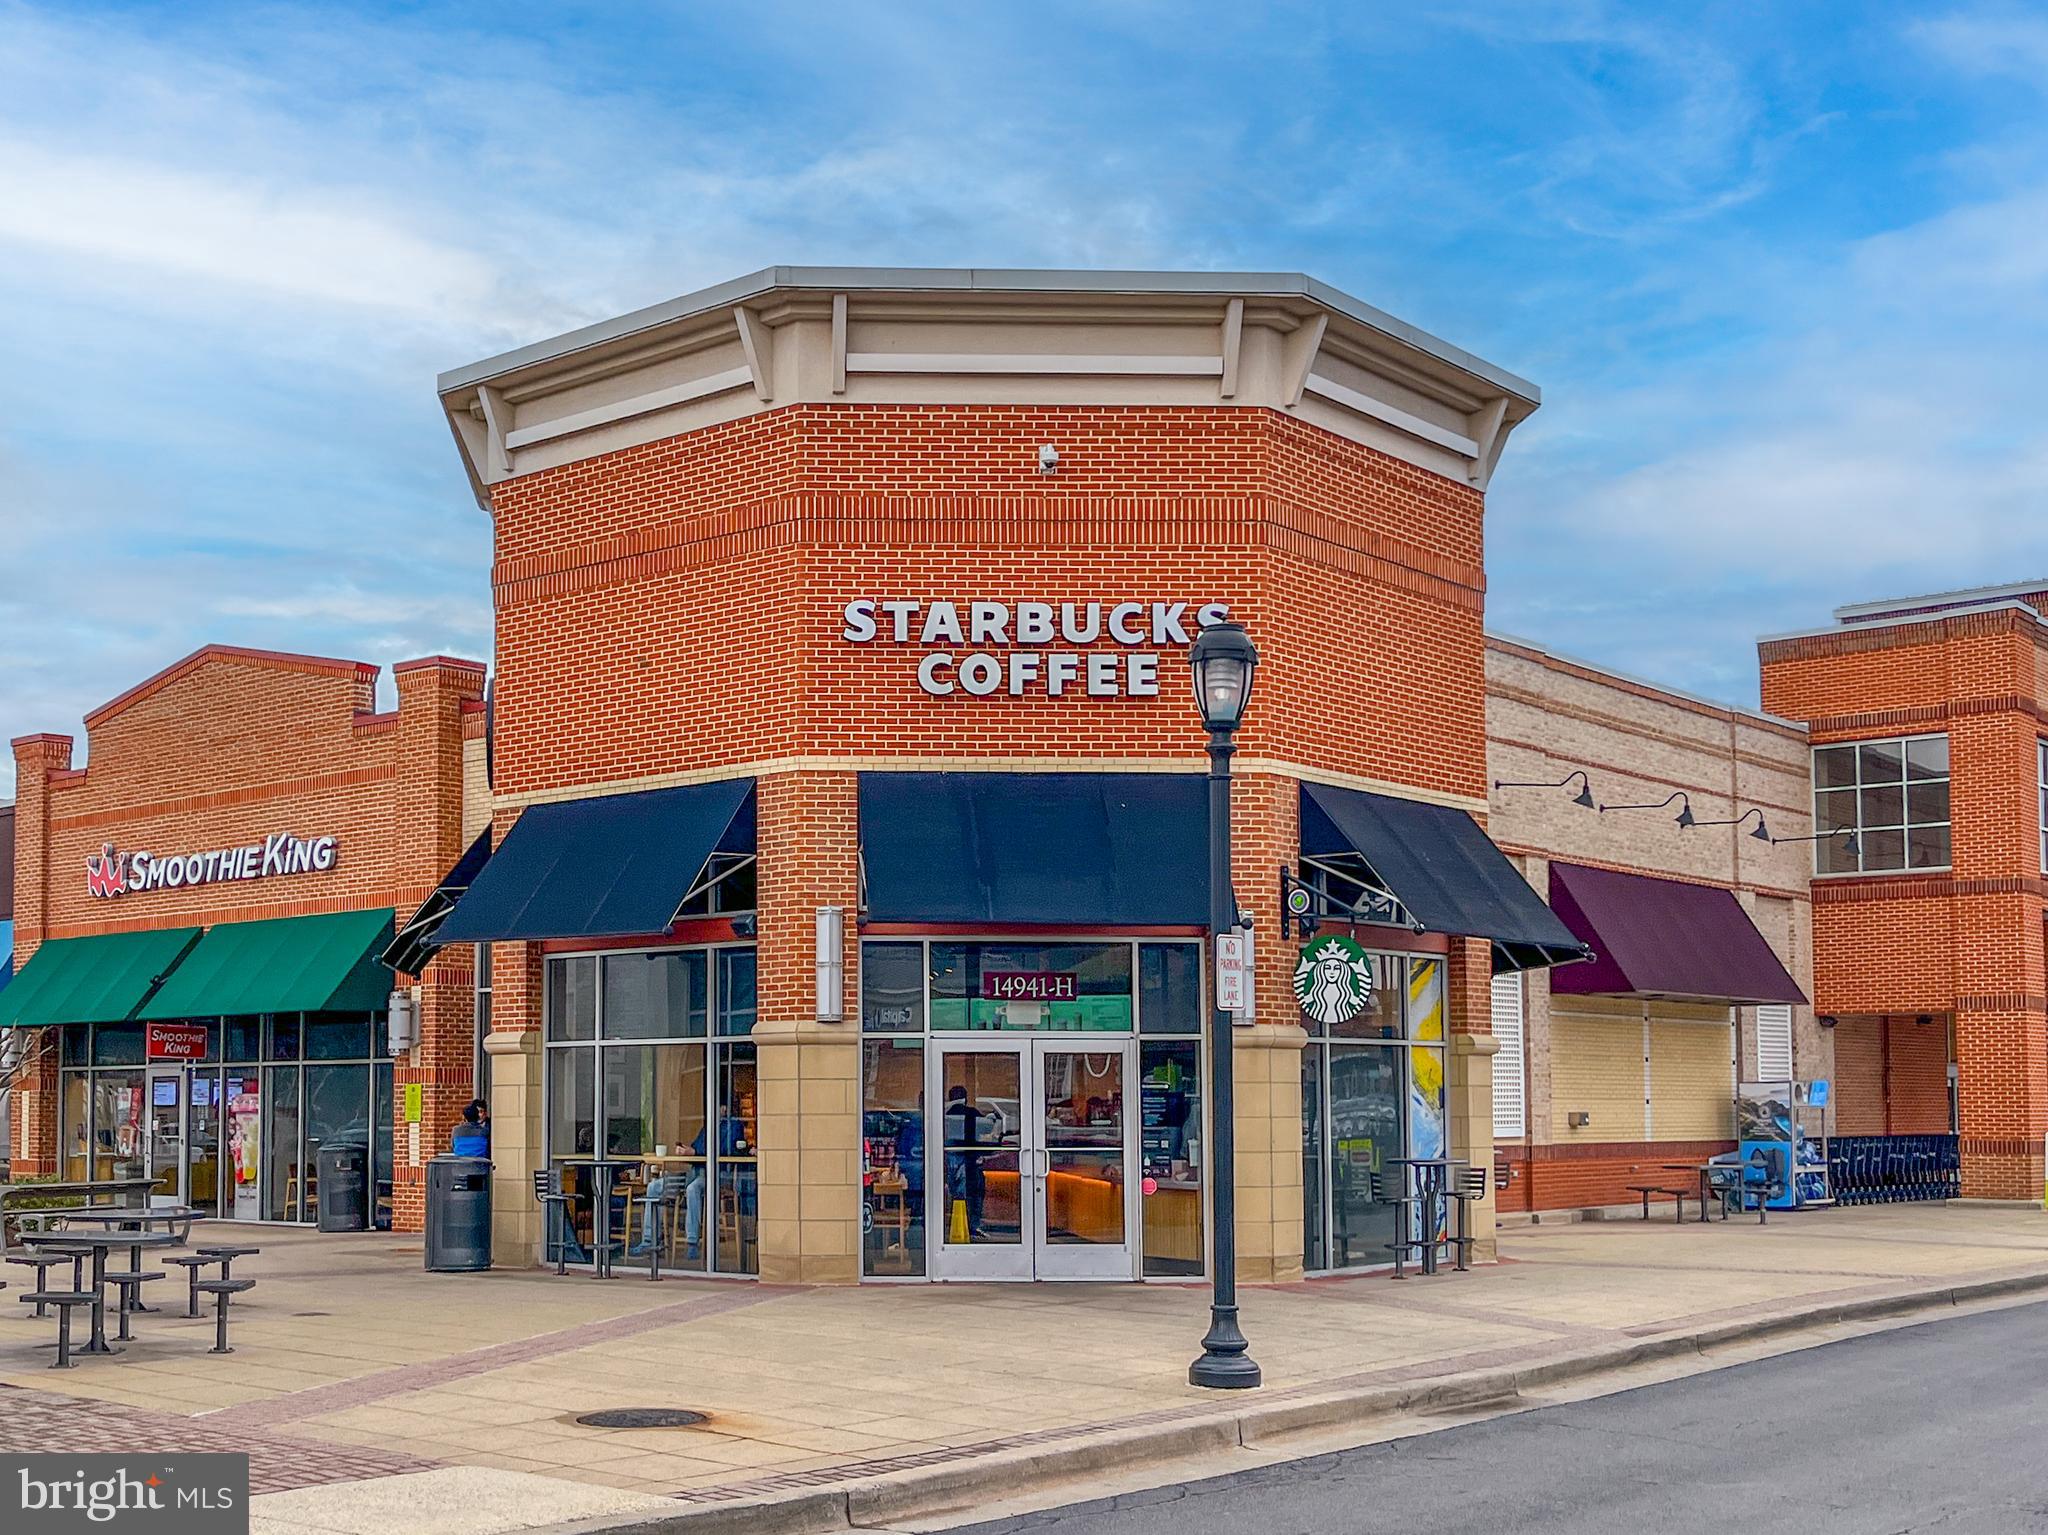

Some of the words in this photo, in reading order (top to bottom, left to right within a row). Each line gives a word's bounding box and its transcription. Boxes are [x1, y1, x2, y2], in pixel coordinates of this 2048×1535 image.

[843, 600, 1230, 645] STARBUCKS
[917, 653, 1159, 695] COFFEE
[129, 847, 260, 891] SMOOTHIE
[1225, 942, 1236, 955] NO
[1220, 959, 1242, 971] PARKING
[992, 976, 1074, 998] 14941-H
[1224, 976, 1237, 987] FIRE
[1223, 990, 1239, 1001] LANE
